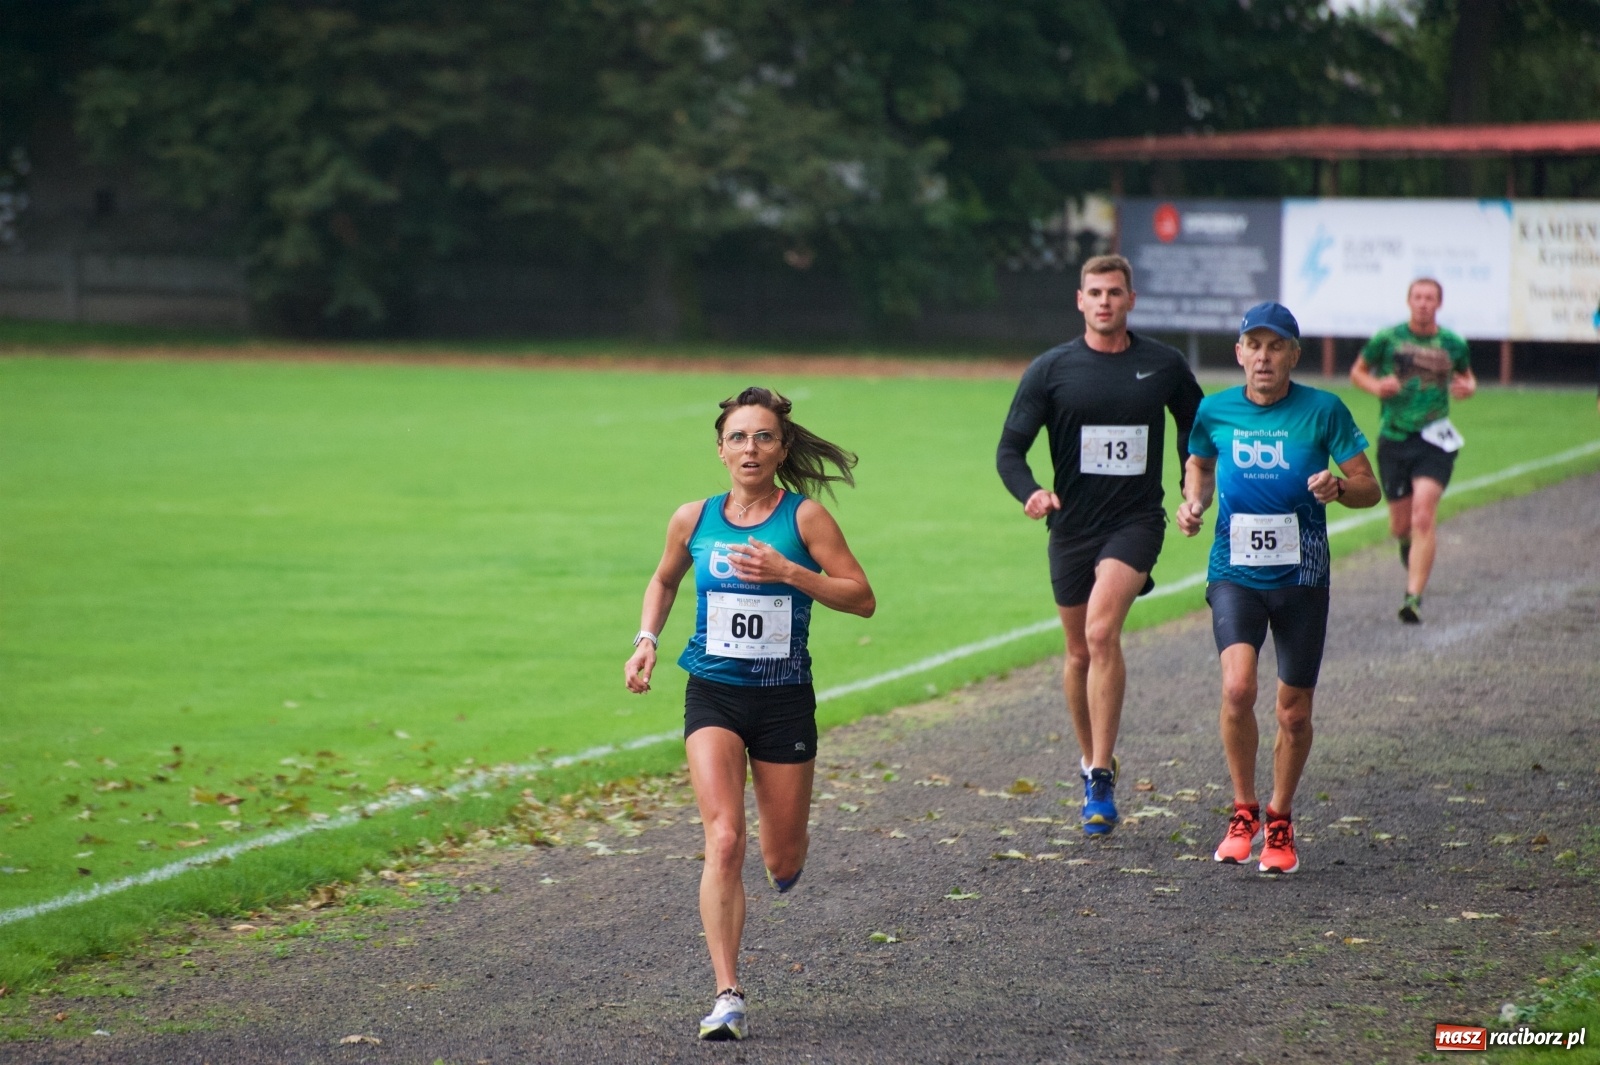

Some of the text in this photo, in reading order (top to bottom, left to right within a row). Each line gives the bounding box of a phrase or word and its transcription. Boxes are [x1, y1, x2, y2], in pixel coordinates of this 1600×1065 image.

[1103, 441, 1128, 460] 13
[1232, 439, 1290, 470] bbl
[1243, 472, 1280, 480] RACIBÓRZ
[1251, 530, 1277, 550] 55
[720, 582, 761, 590] RACIBÓRZ
[731, 613, 763, 639] 60
